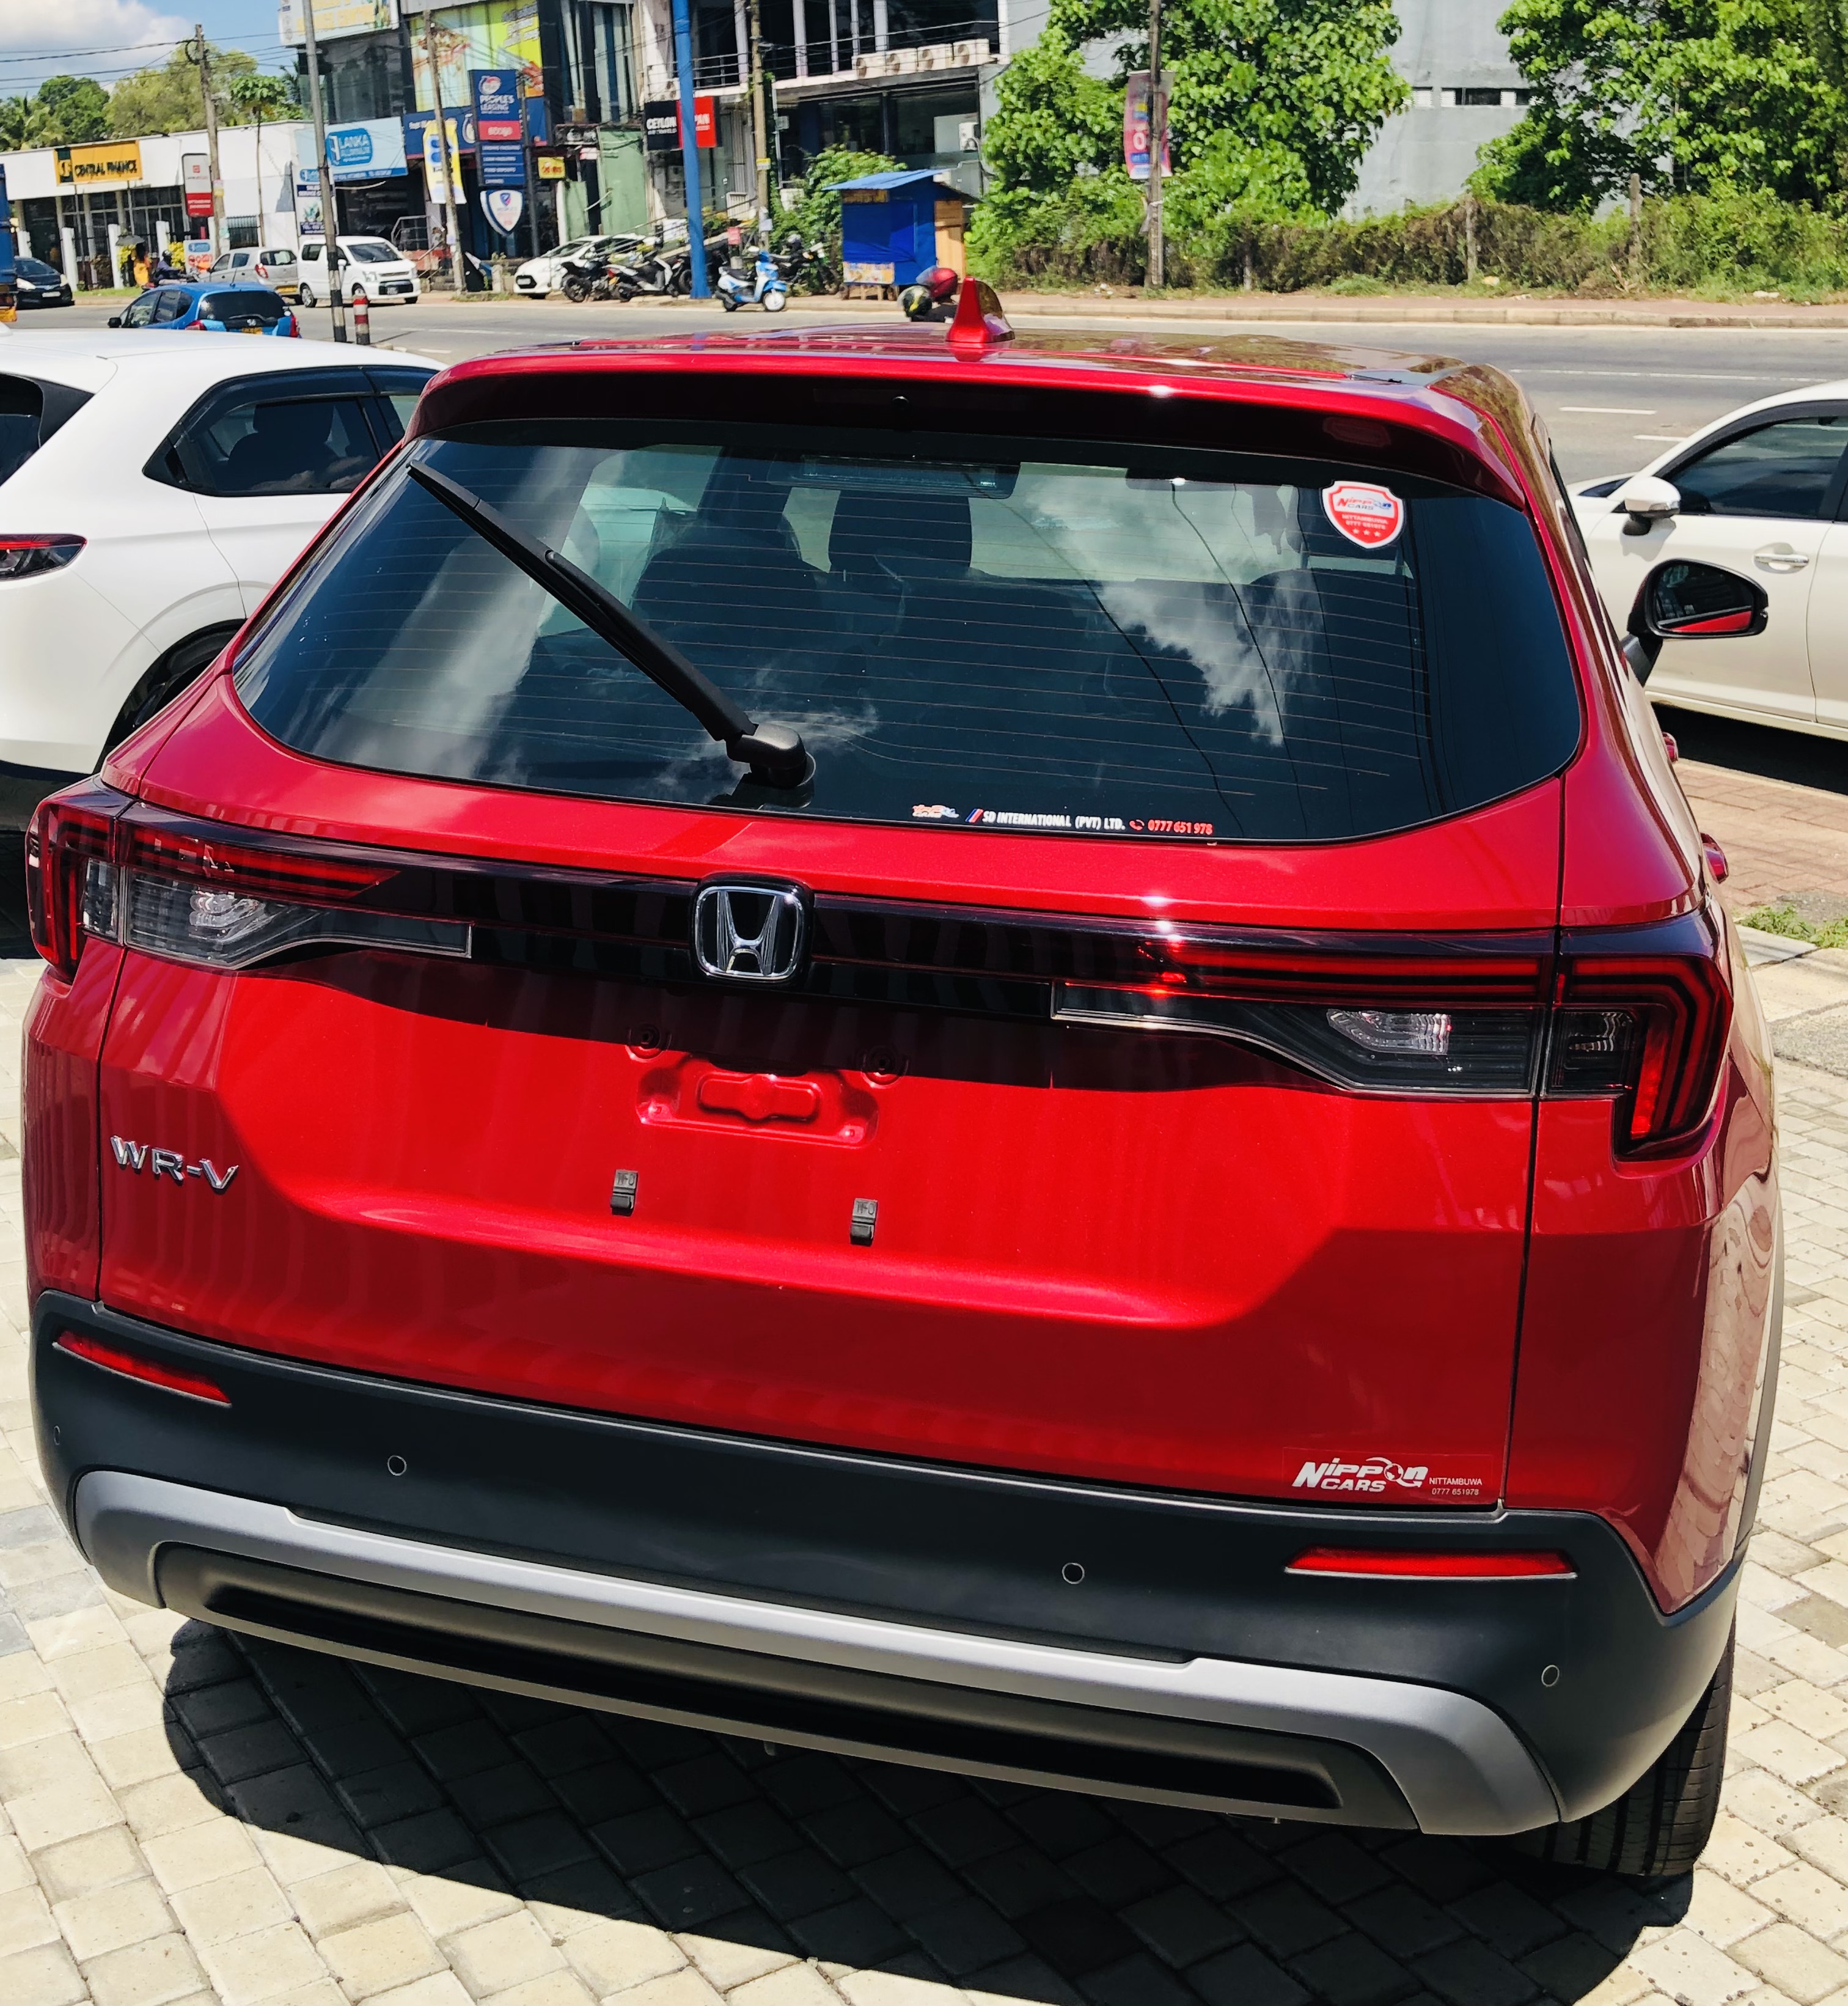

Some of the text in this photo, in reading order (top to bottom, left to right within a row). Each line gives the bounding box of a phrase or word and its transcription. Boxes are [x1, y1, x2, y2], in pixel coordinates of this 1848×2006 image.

[647, 116, 676, 130] CEYLON
[1342, 514, 1388, 525] NITTAMBUWA
[982, 810, 1213, 836] SD INTERNATIONAL (PVT) LTD. 0777 651 978
[111, 1135, 239, 1189] WR-V
[1320, 1478, 1387, 1493] CARS
